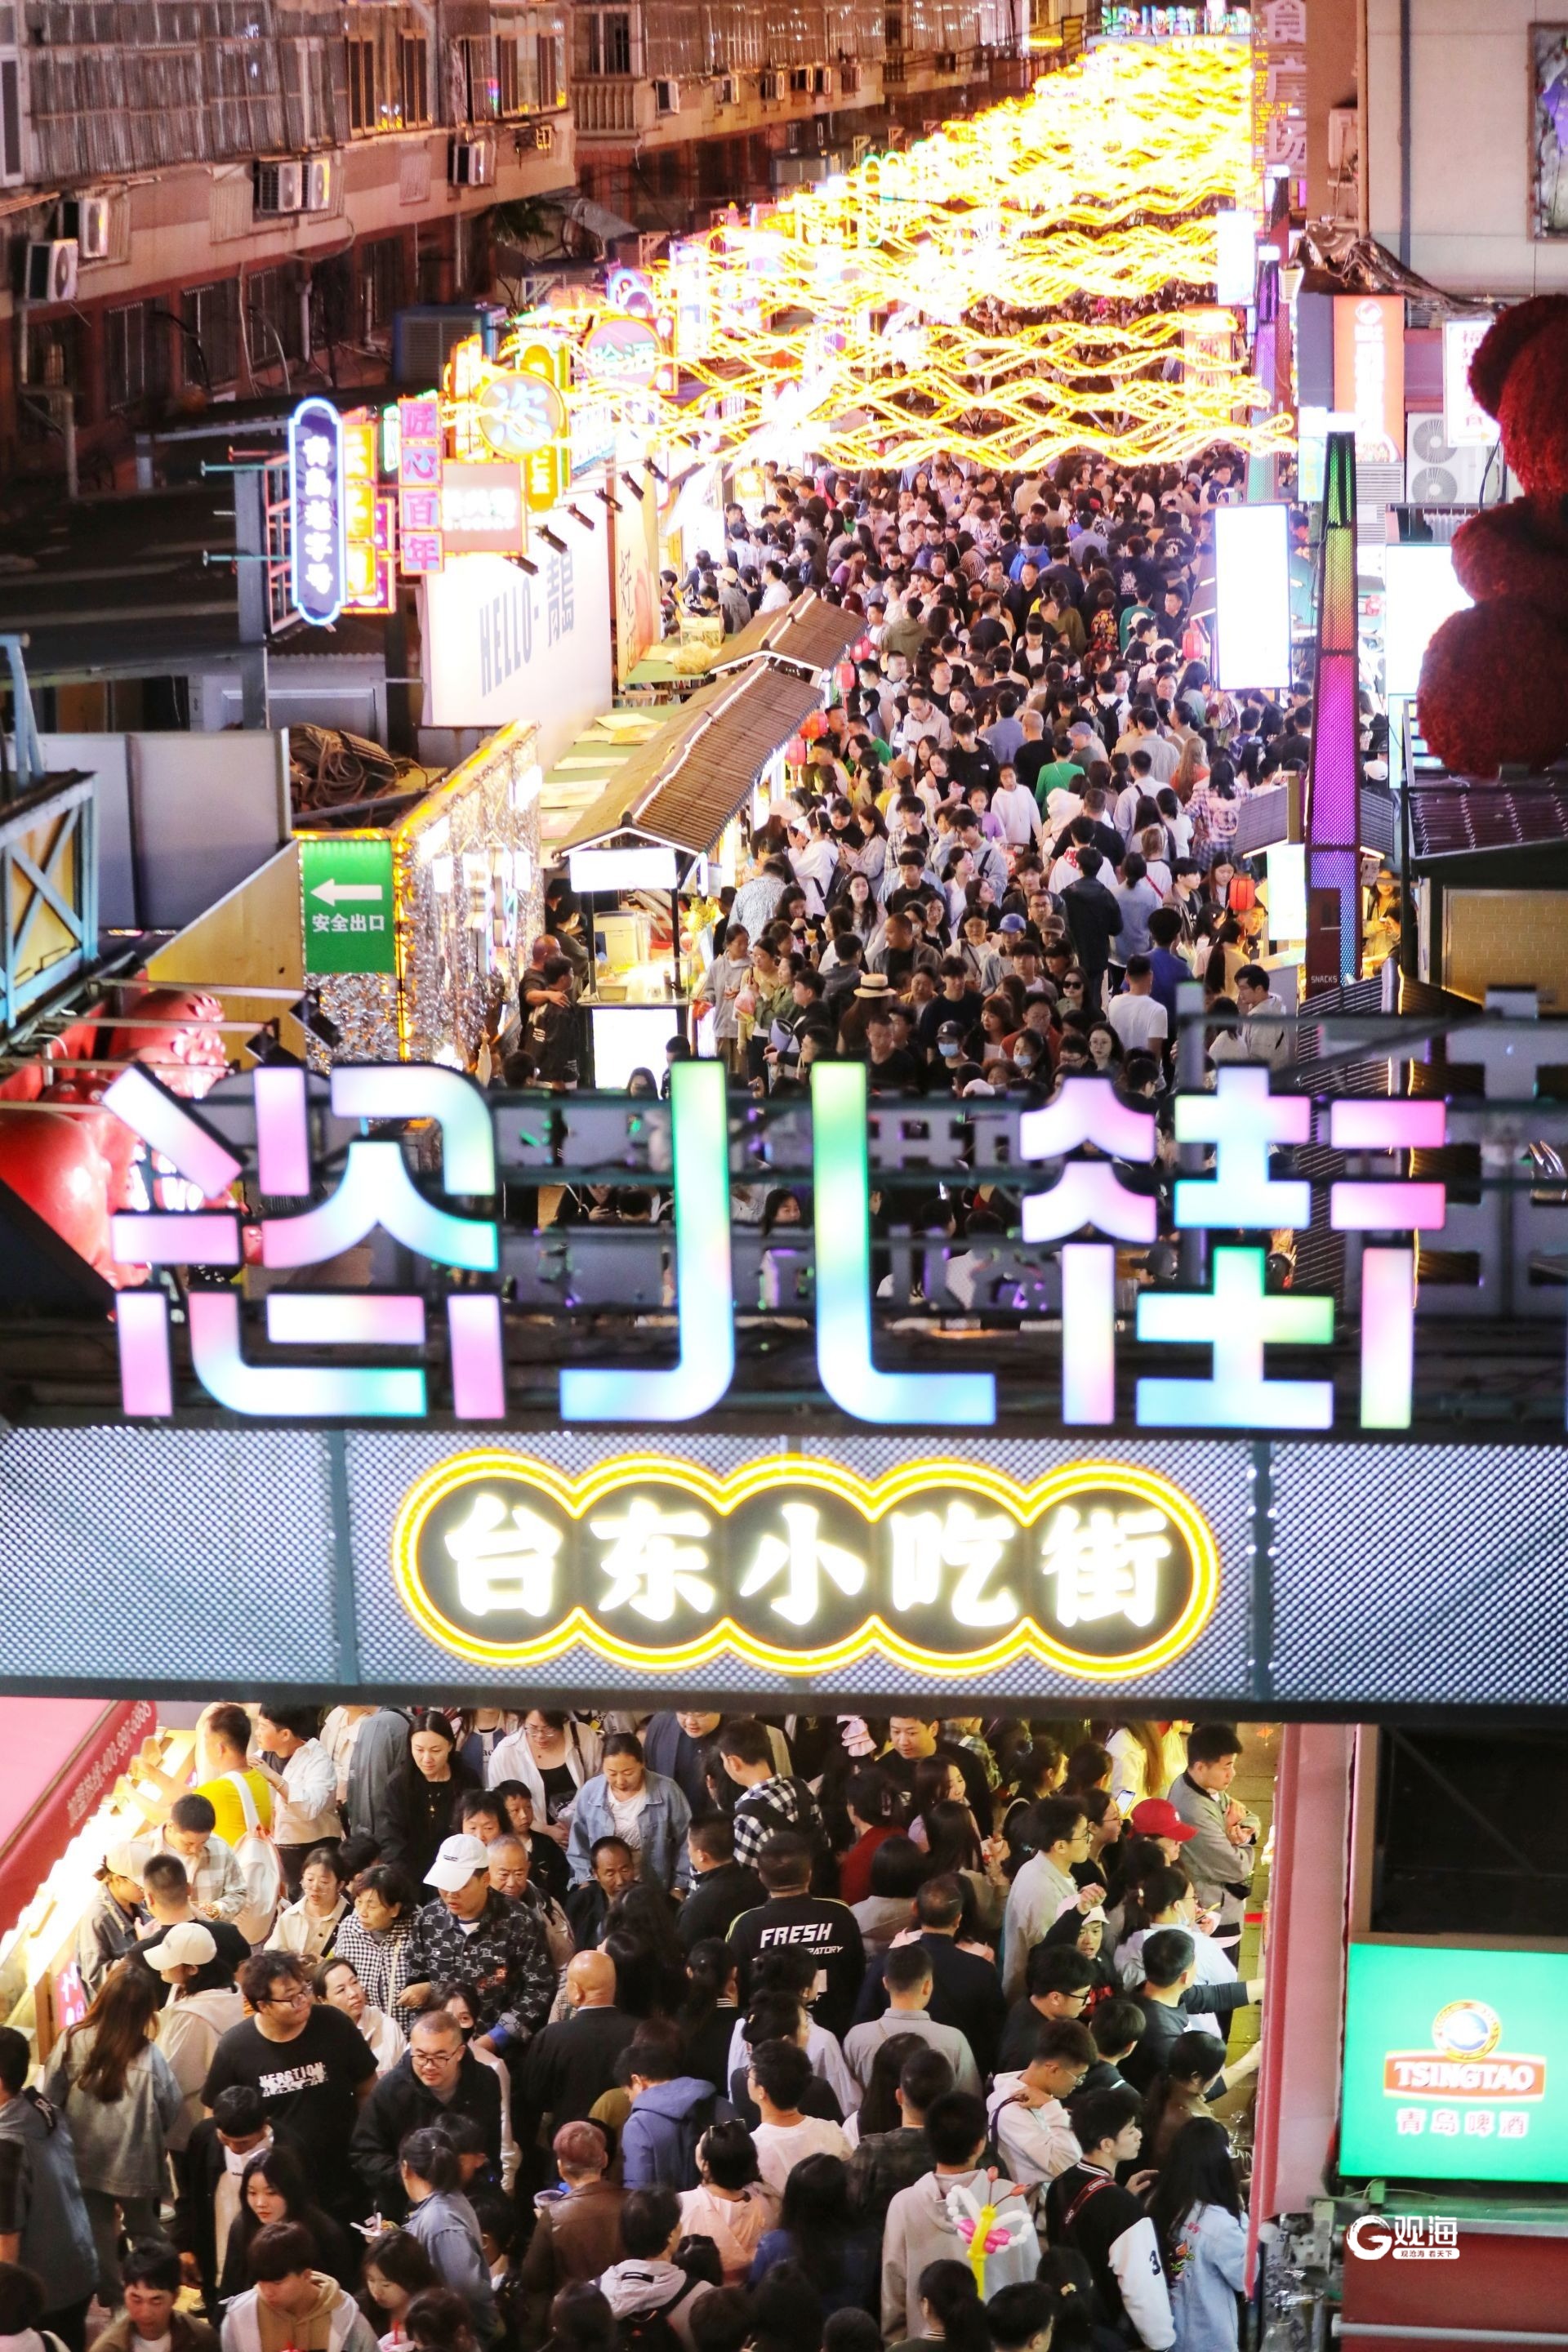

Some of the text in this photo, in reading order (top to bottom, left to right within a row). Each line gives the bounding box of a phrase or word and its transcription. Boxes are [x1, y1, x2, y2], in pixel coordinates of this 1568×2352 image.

[404, 404, 439, 570] 匠心百年
[312, 912, 385, 933] 安全出口
[1310, 974, 1338, 984] SNACKS
[443, 1490, 1174, 1628] 台东小吃街
[760, 1922, 833, 1949] FRESH
[1393, 2060, 1535, 2091] TSINGTAO
[1396, 2107, 1530, 2137] 青岛啤酒
